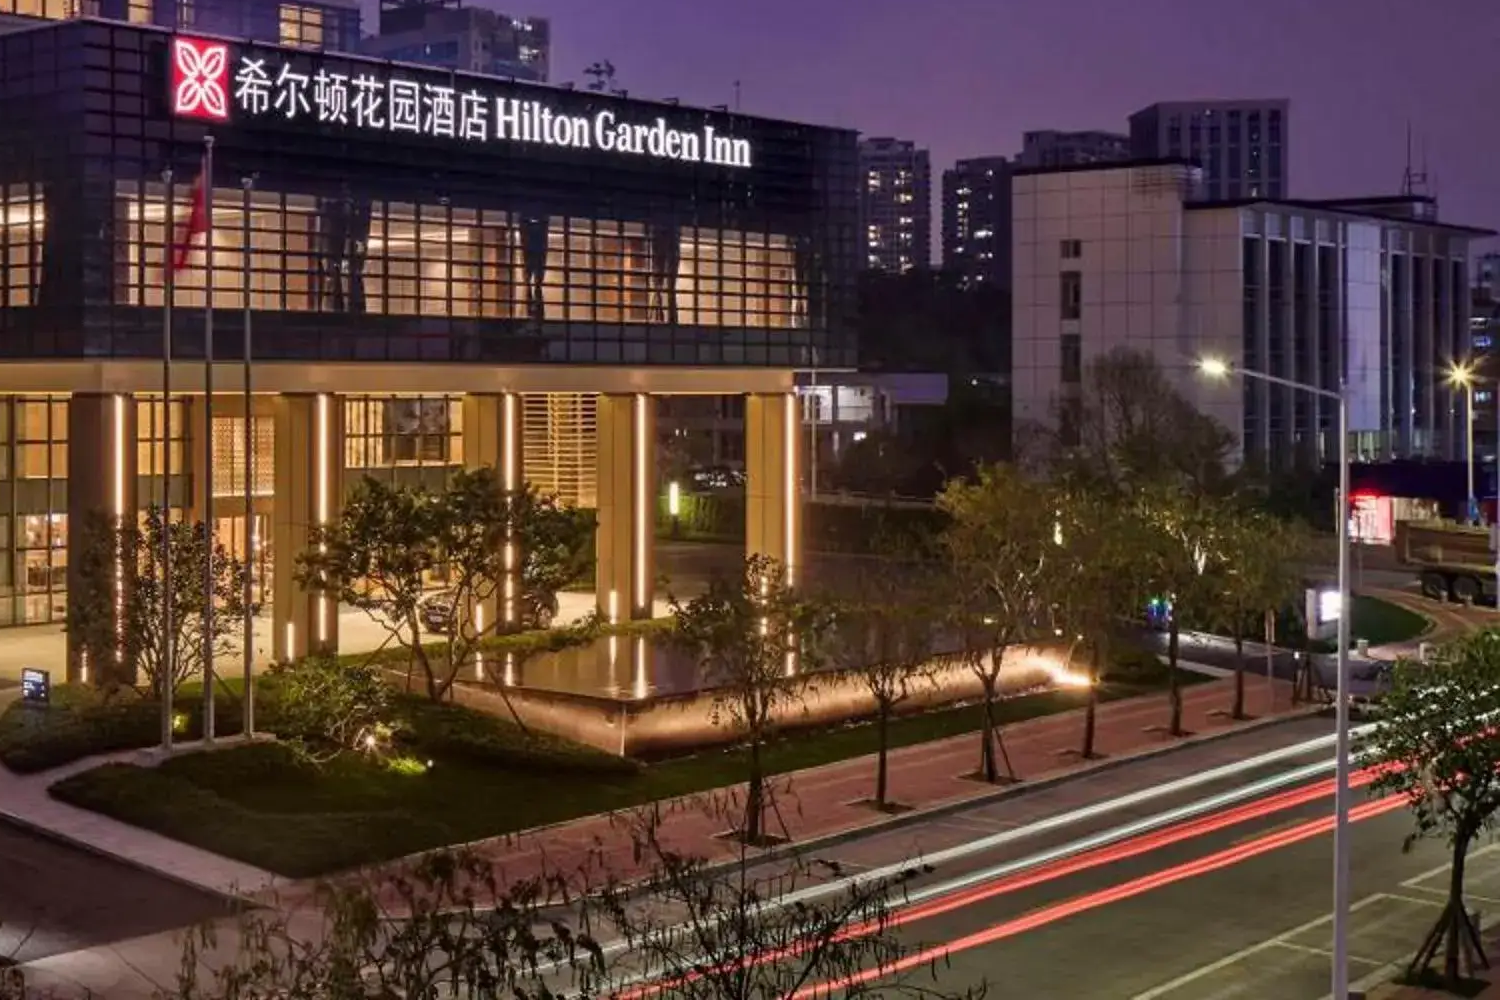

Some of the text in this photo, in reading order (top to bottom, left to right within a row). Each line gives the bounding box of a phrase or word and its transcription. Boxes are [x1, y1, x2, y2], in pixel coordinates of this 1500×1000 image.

[235, 57, 488, 141] 希尔顿花园酒店
[496, 98, 752, 167] Hilton Garden Inn
